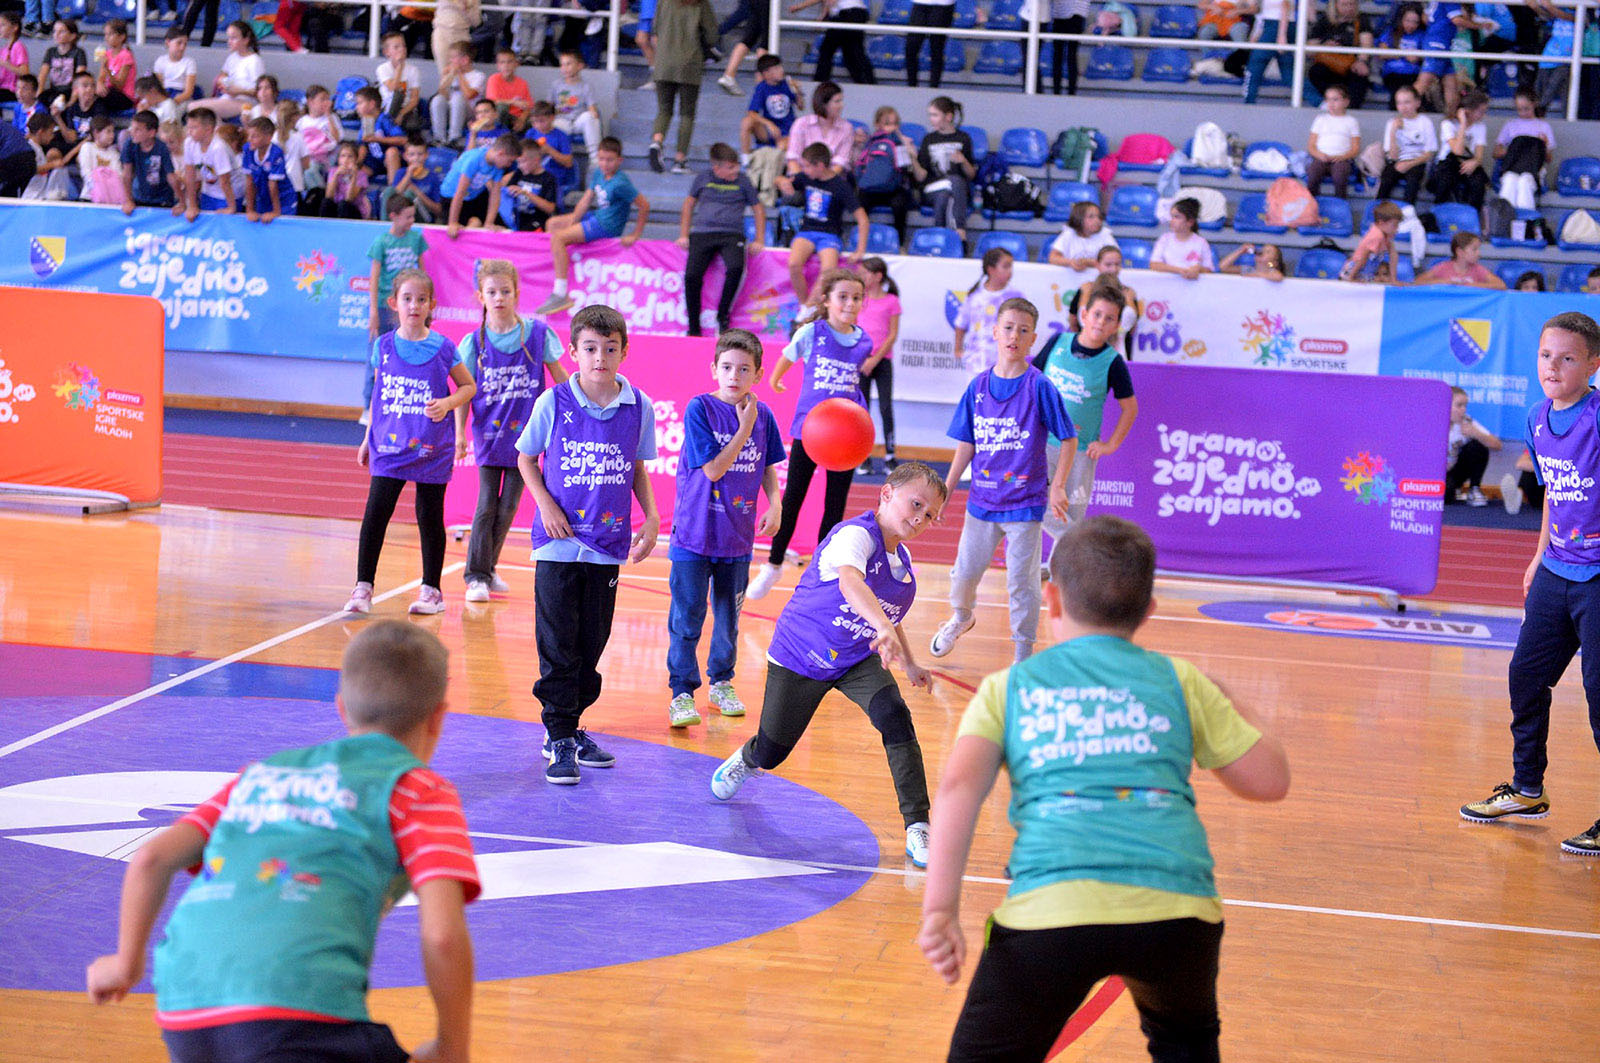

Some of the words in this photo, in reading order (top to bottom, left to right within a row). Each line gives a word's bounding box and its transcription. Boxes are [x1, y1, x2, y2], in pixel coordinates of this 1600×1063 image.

[124, 227, 239, 264] igramo.
[163, 289, 250, 330] njamo.
[902, 340, 952, 354] FEDERALNO
[901, 355, 924, 368] RADA
[1291, 358, 1348, 371] SPORTSKE
[381, 372, 430, 390] igramo.
[1458, 372, 1528, 391] MINISTARSTVO
[106, 391, 140, 403] plazma
[96, 404, 144, 421] SPORTSKE
[383, 401, 425, 418] sanjam
[95, 414, 117, 426] IGRE
[974, 413, 1017, 430] igramo.
[94, 424, 133, 439] MLADIH
[561, 437, 621, 458] igramo.
[1157, 423, 1286, 462] igramo.
[1536, 454, 1576, 471] gramo.
[564, 470, 626, 491] sanjamo.
[1403, 482, 1441, 493] plazma
[1096, 493, 1135, 507] POLITIKE
[1158, 487, 1301, 526] sanjamo.
[1391, 497, 1444, 511] SPORTSKE
[1391, 509, 1415, 521] IGRE
[1390, 520, 1434, 535] MLADIH
[1018, 686, 1136, 716] igramo.
[1028, 731, 1158, 768] sanjamo.
